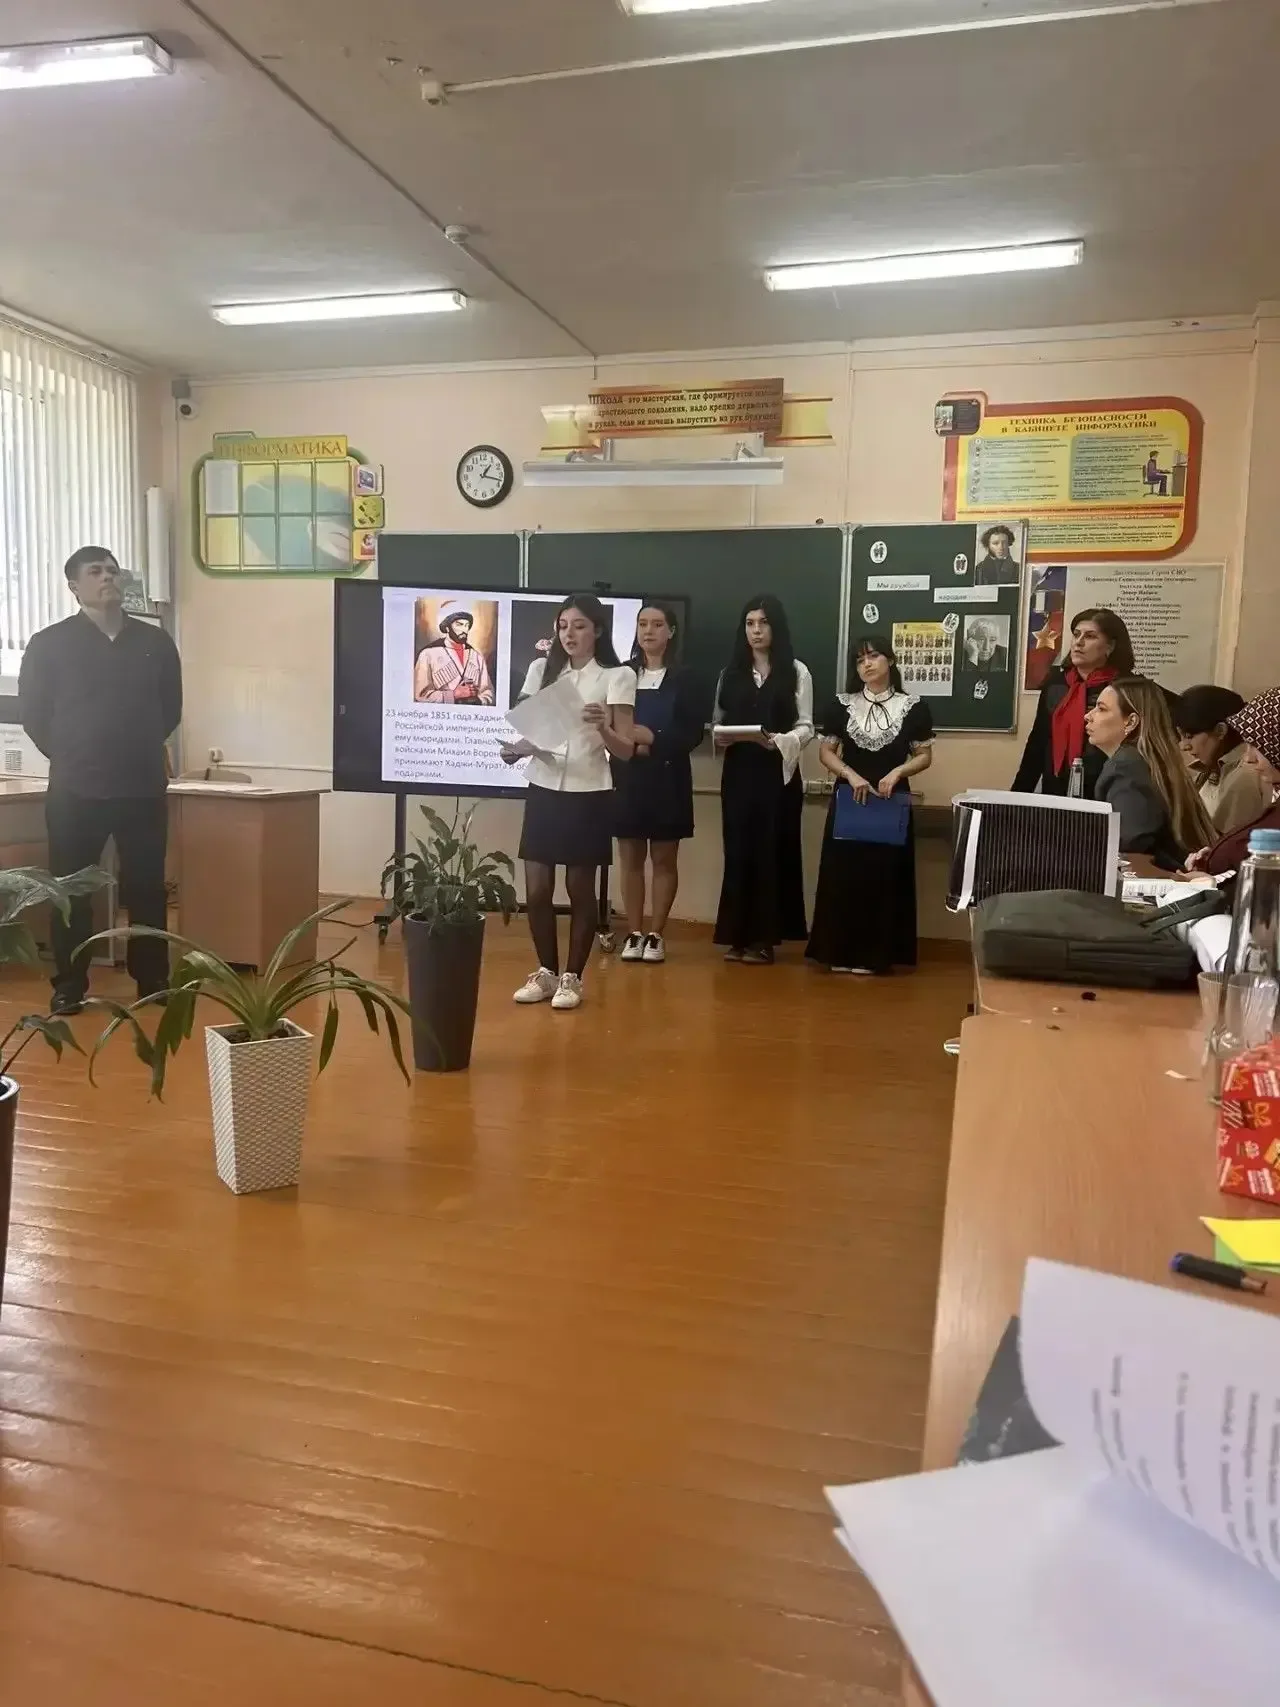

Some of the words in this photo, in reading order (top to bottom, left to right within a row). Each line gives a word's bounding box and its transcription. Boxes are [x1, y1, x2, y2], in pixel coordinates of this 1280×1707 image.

[642, 394, 687, 403] мастерская,
[648, 406, 688, 414] поколения,
[709, 403, 736, 413] крепко
[676, 416, 717, 426] выпустить
[1009, 416, 1057, 426] ТЕХНИКА
[1063, 412, 1149, 424] БЕЗОПАСНОСТИ
[1001, 426, 1008, 434] В
[1014, 424, 1069, 433] КАБИНЕТЕ
[1075, 420, 1158, 431] ИНФОРМАТИКИ
[480, 453, 488, 461] 12
[385, 709, 396, 717] 23
[398, 711, 429, 720] ноября
[431, 711, 451, 720] 1851
[453, 713, 472, 722] года
[394, 721, 443, 732] Российской
[445, 725, 484, 736] империи
[394, 735, 411, 743] ему
[394, 745, 436, 754] войсками
[437, 748, 471, 757] Михаил
[394, 759, 443, 768] принимают
[445, 760, 507, 772] Хаджи-Мурата
